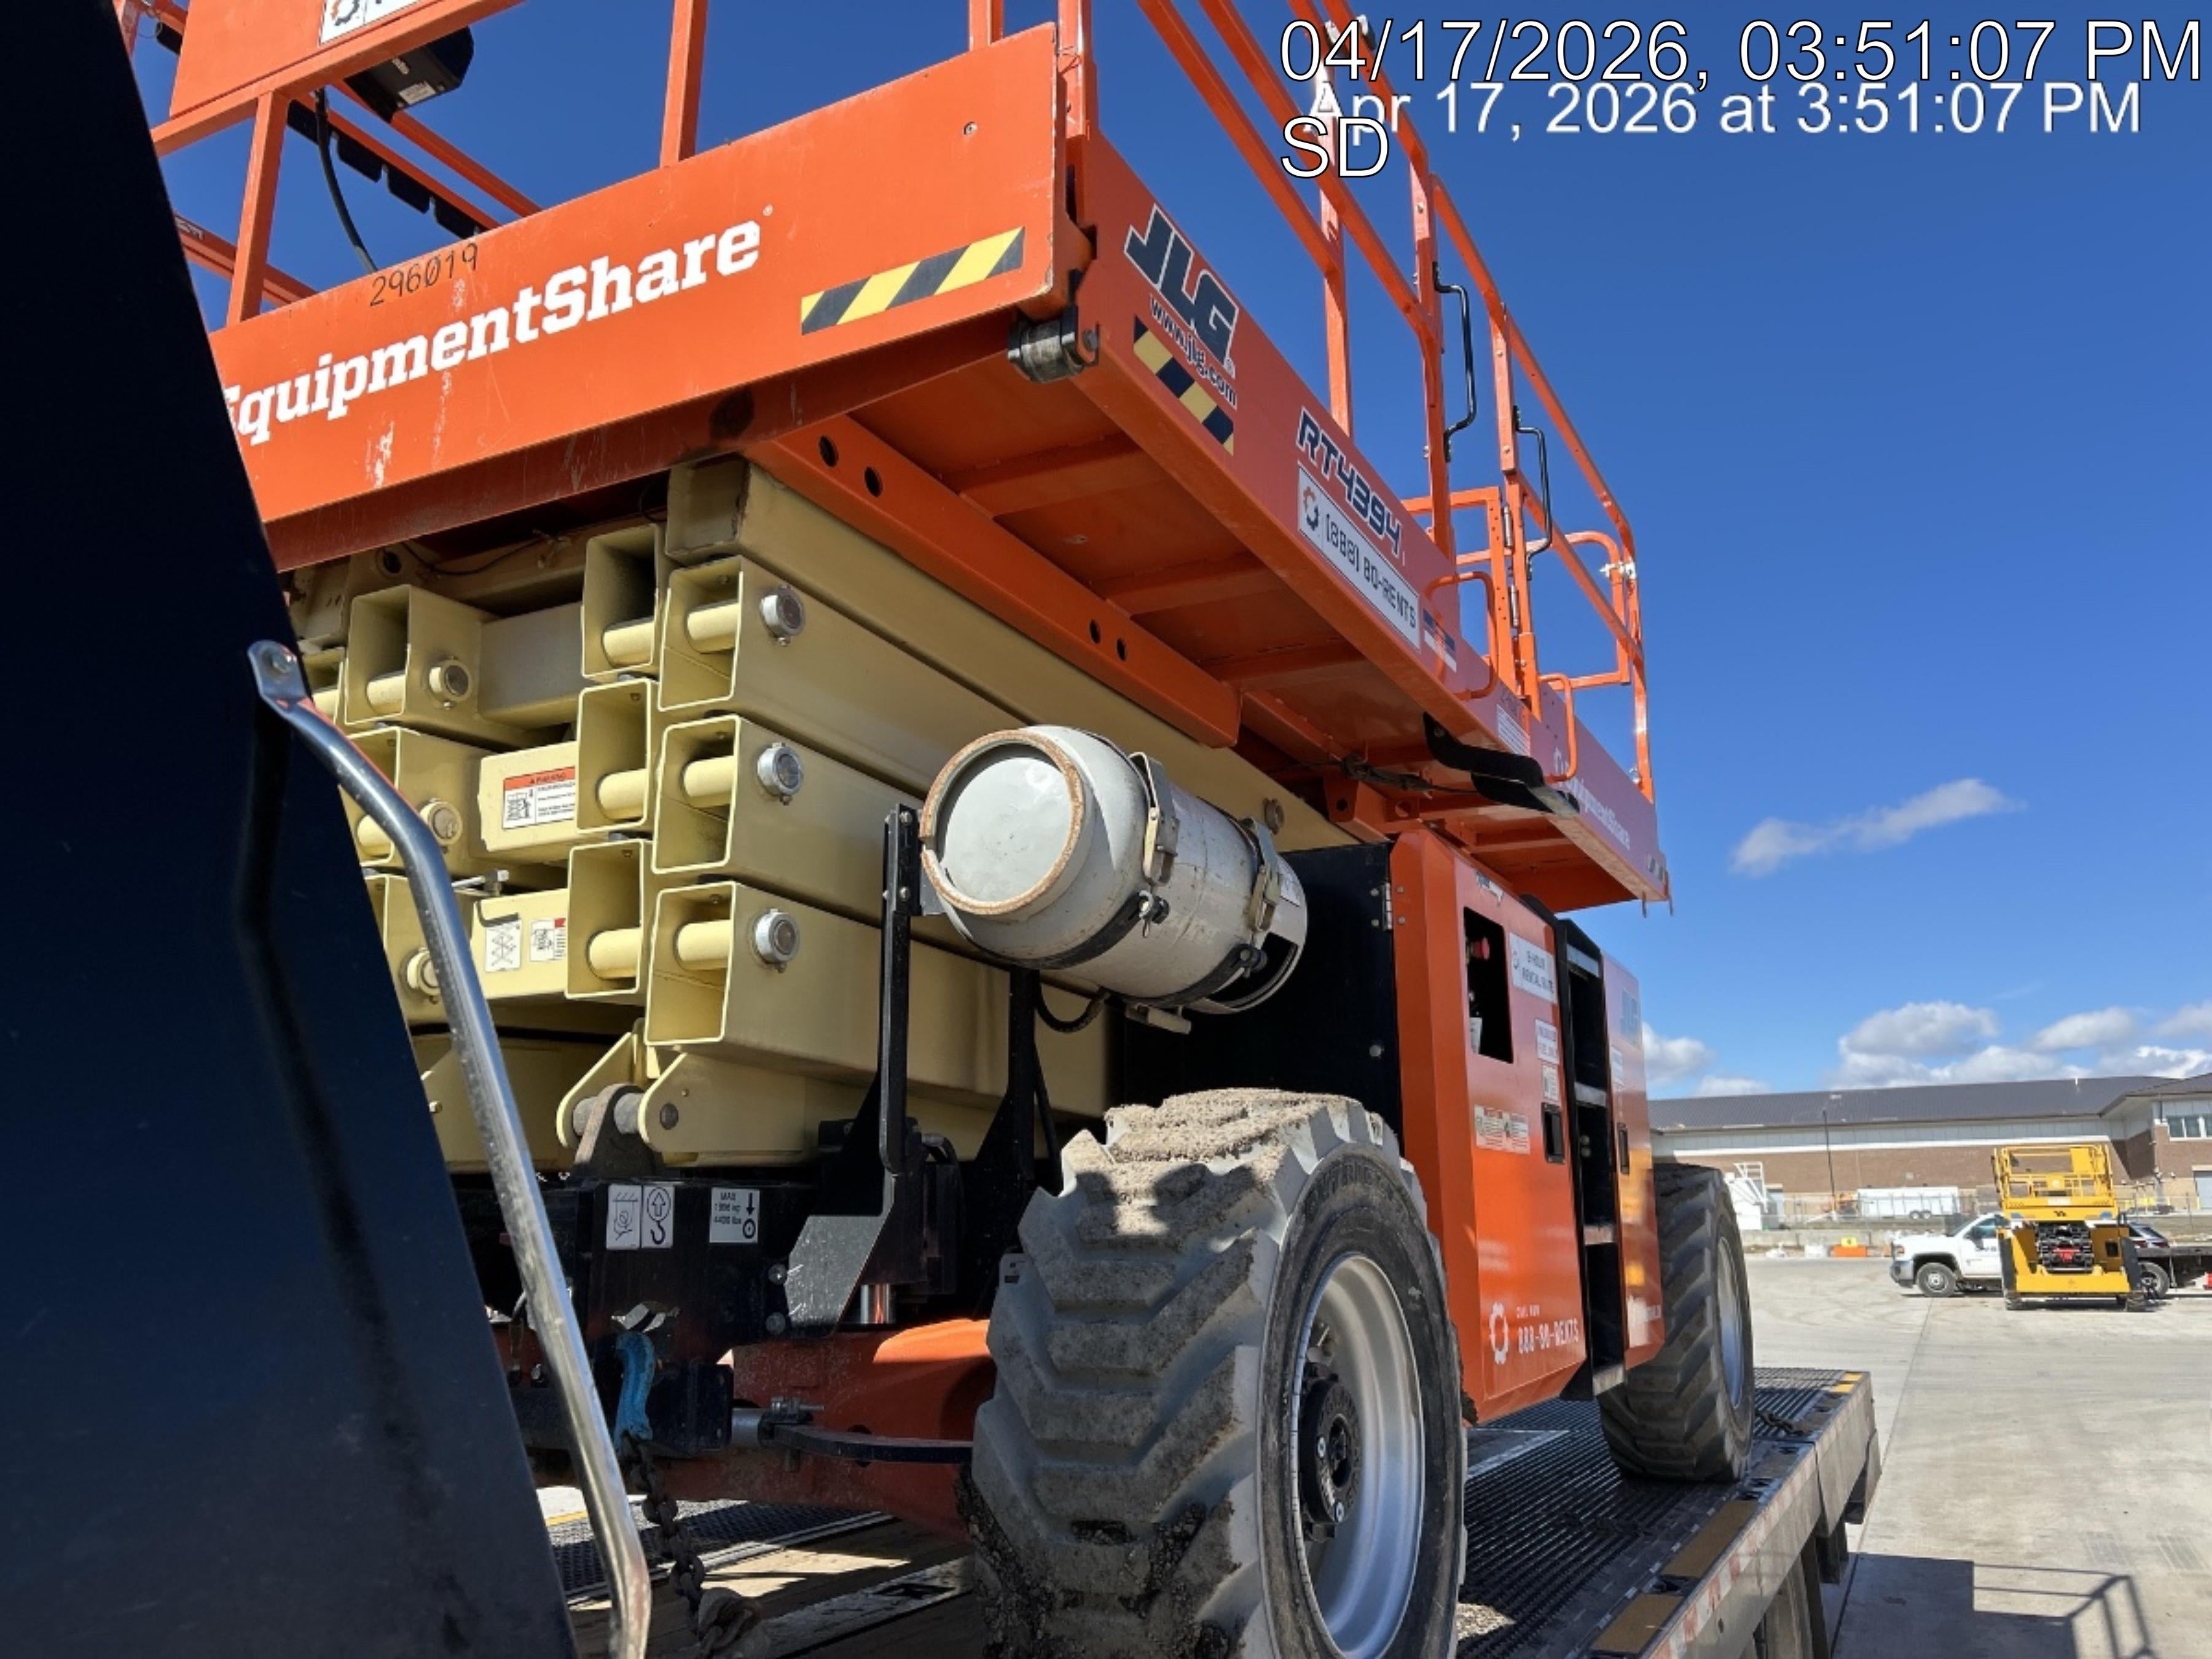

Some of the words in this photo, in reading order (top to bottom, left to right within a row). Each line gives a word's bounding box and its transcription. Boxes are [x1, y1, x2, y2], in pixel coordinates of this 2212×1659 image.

[370, 243, 477, 307] 296019
[1123, 203, 1239, 370] JLG
[1149, 292, 1237, 410] www.jlg.com
[1296, 406, 1402, 559] RT4394
[1325, 512, 1359, 571] (888)
[1363, 555, 1417, 629] 80-RENTS
